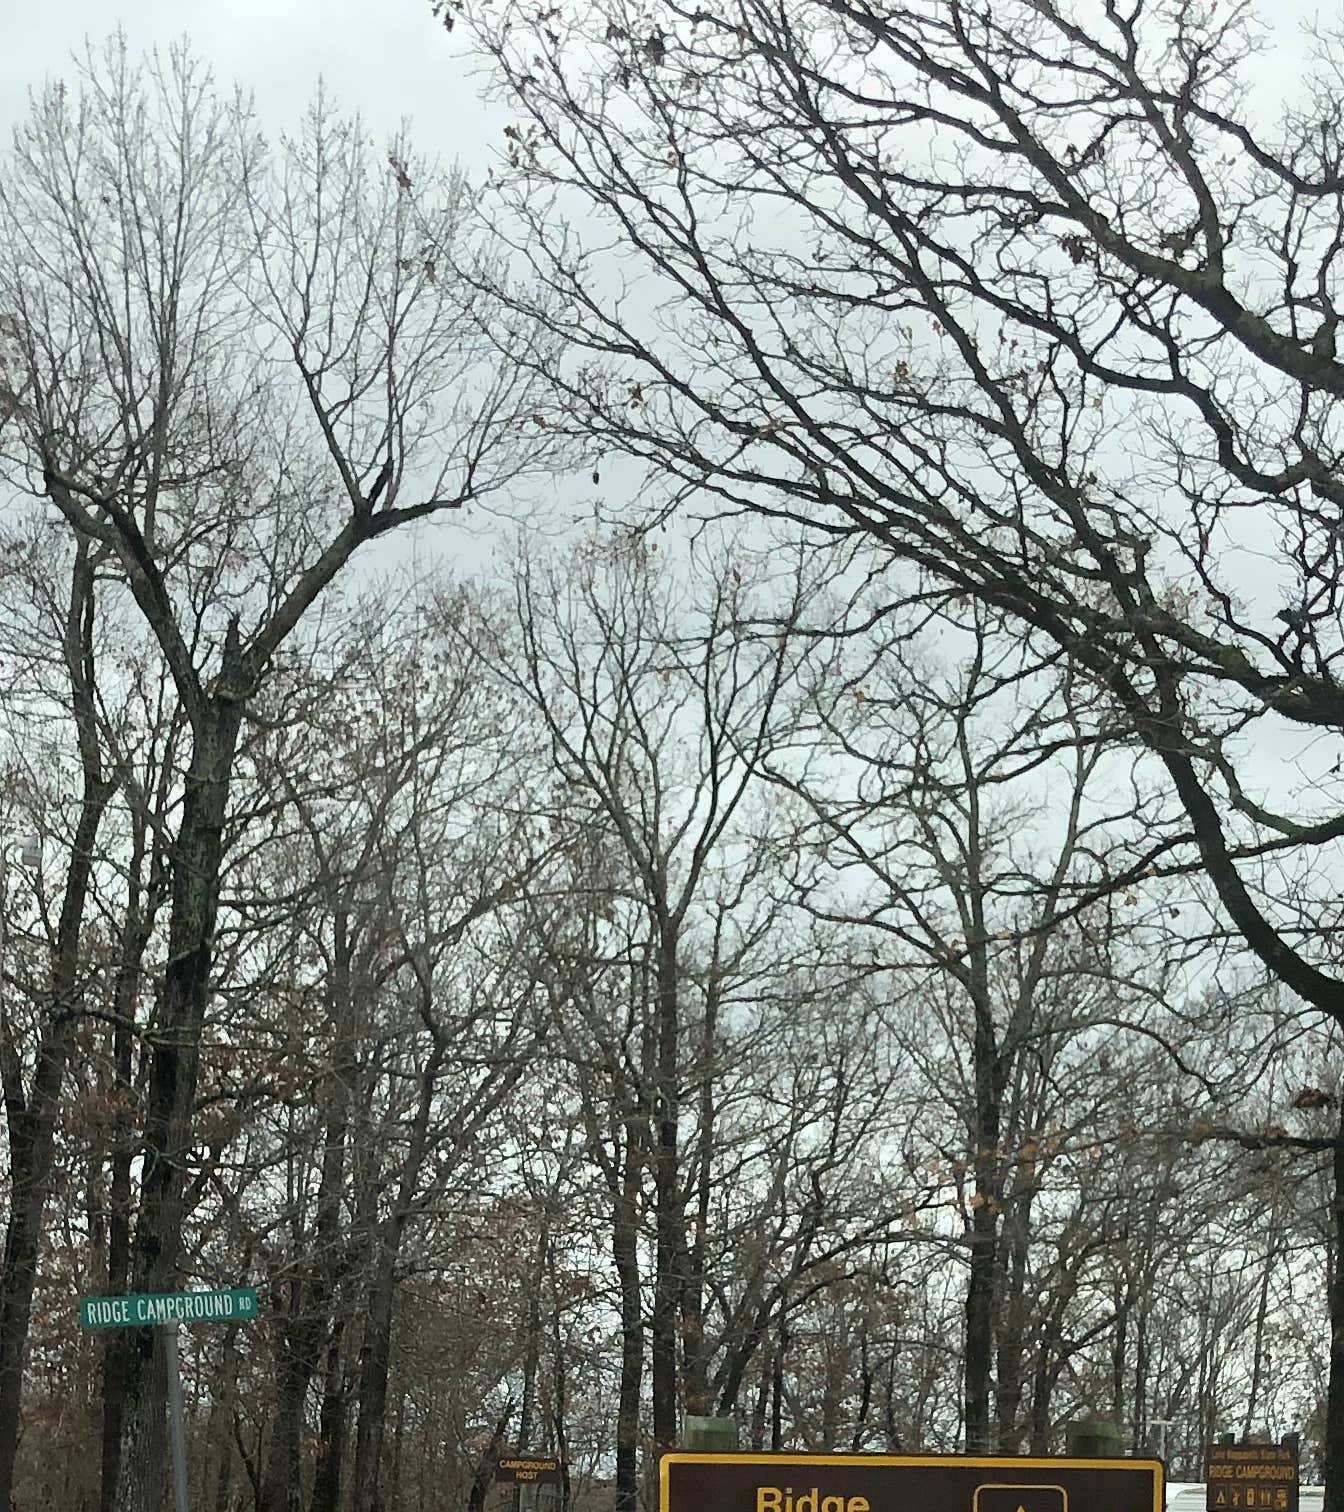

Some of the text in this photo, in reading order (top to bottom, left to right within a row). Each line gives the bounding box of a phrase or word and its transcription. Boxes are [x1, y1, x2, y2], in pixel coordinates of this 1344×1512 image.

[87, 1294, 252, 1324] RIDGE CAMPGROUND RD
[499, 1459, 556, 1471] CAMPGROUND
[1237, 1464, 1294, 1480] CAMPGROUND
[516, 1471, 538, 1480] HOST
